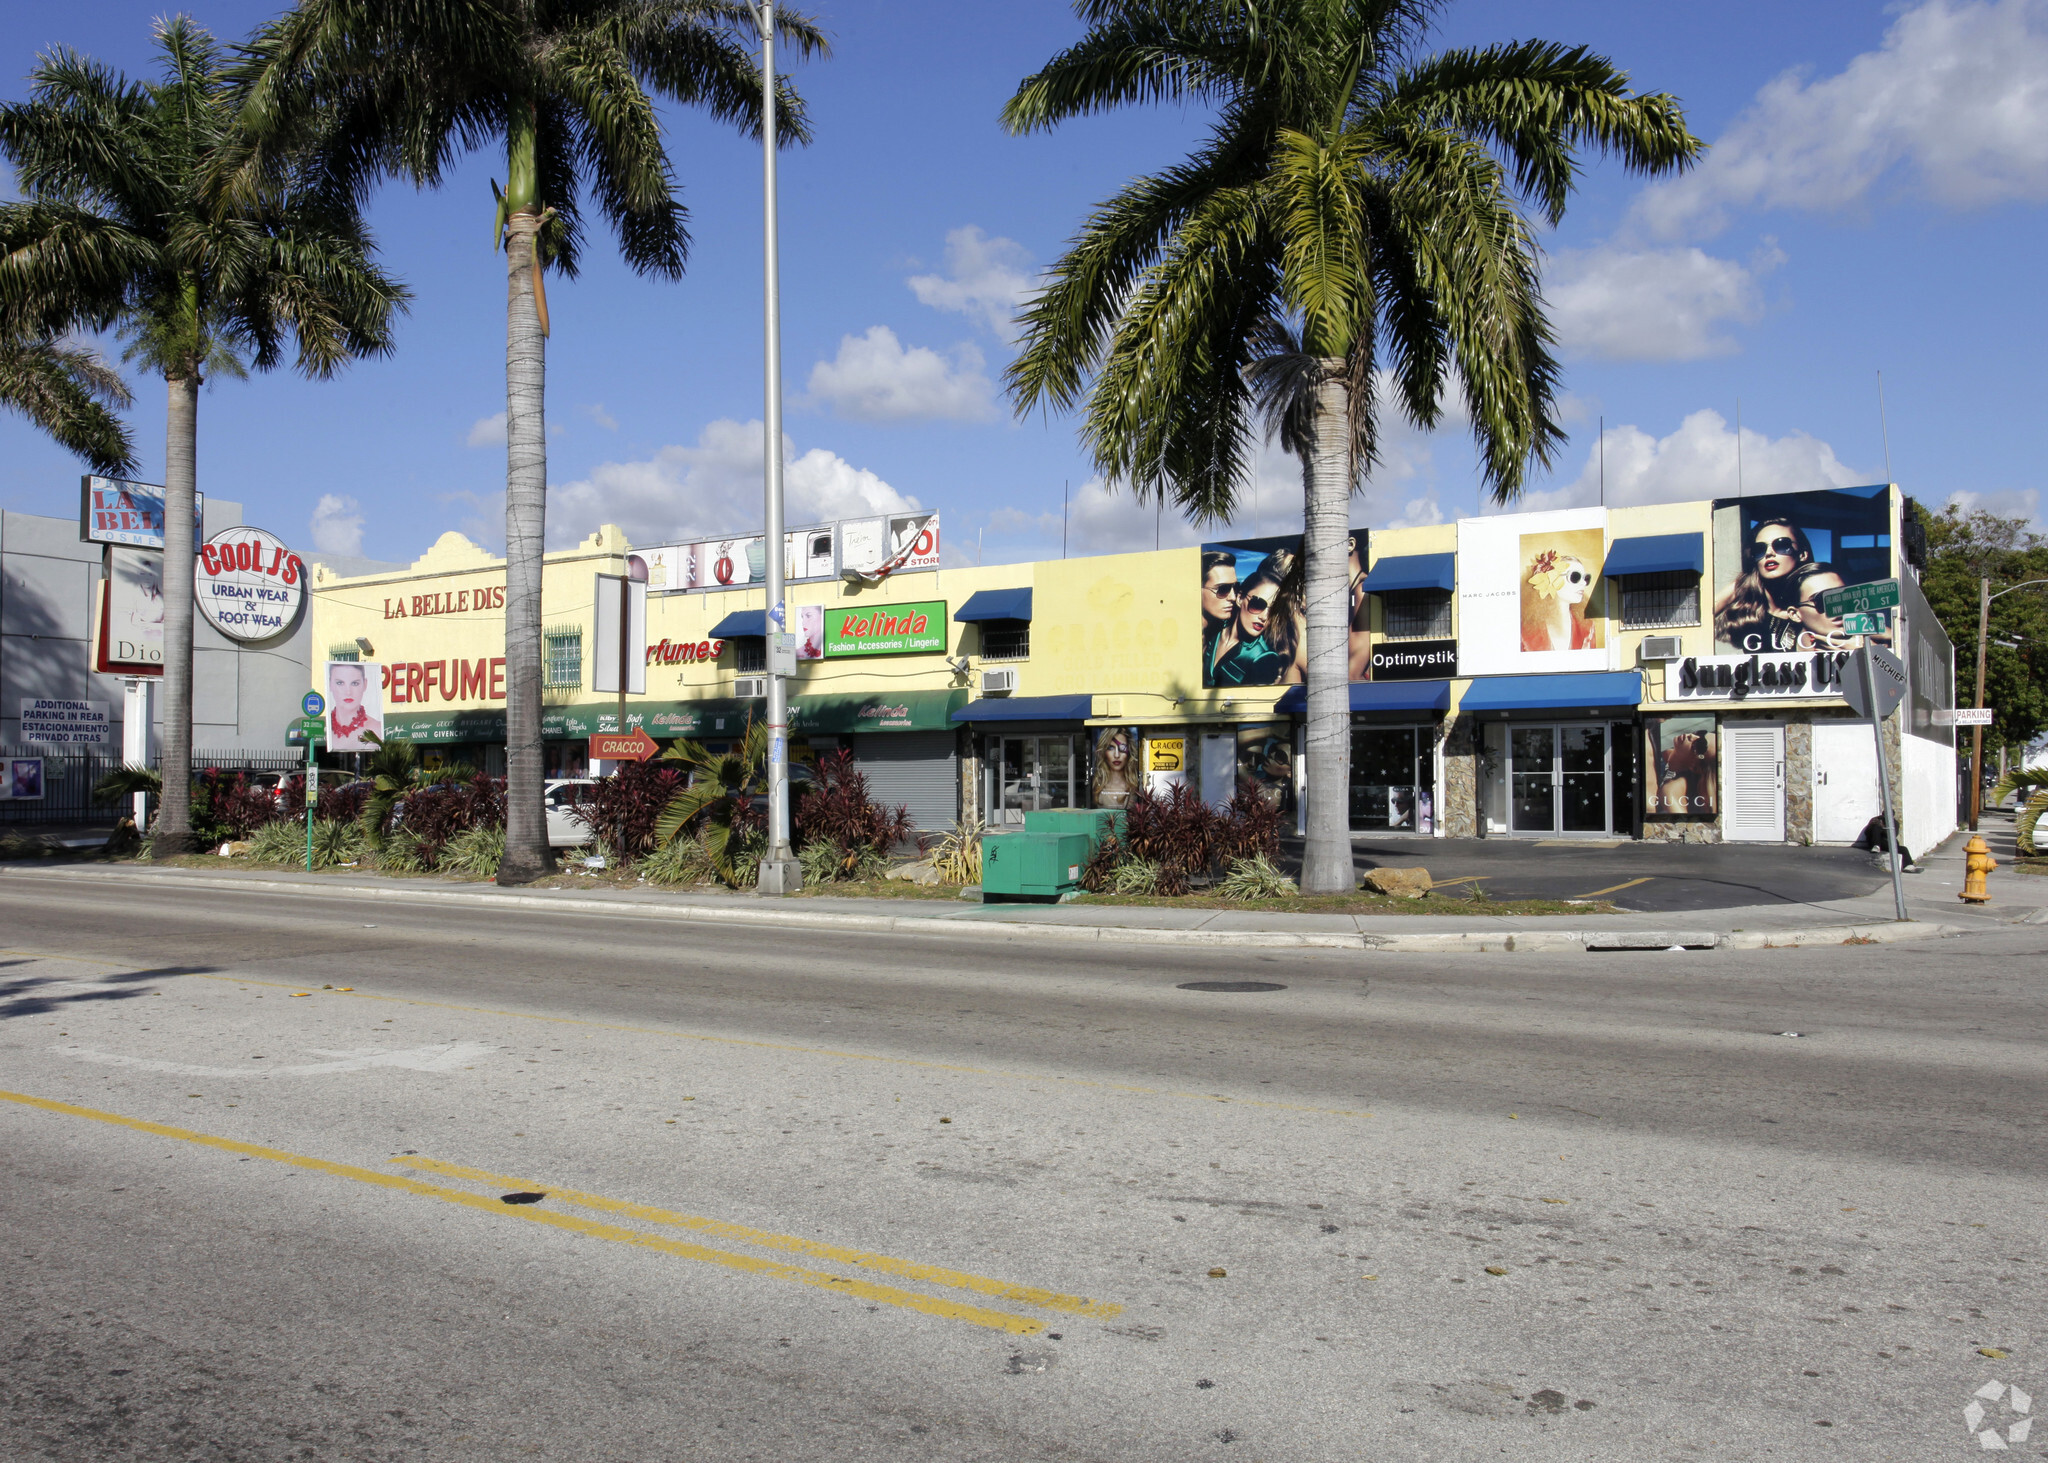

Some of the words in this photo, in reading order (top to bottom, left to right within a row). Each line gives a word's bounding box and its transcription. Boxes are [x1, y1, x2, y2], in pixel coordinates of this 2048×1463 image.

[93, 491, 136, 509] LA
[202, 540, 263, 576] COOL
[266, 547, 302, 585] J'S
[212, 584, 253, 599] URBAN
[256, 588, 289, 602] WEAR
[1486, 590, 1517, 598] JACOBS
[1868, 586, 1876, 595] THE
[1876, 583, 1896, 594] AMERICAS
[244, 601, 257, 612] &
[384, 597, 408, 619] LA
[412, 590, 469, 616] BELLE
[473, 585, 507, 610] DIS
[1832, 605, 1843, 614] NW
[1853, 597, 1870, 613] 20
[1880, 596, 1890, 606] ST
[219, 611, 249, 624] FOOT
[252, 614, 282, 627] WEAR
[840, 609, 928, 639] Kelinda
[1845, 620, 1857, 631] NW
[1861, 617, 1875, 632] 23
[828, 642, 856, 652] Fashion
[858, 640, 903, 651] Accessories
[909, 636, 940, 649] Lingerie
[1743, 630, 1861, 652] GUCCI
[118, 640, 161, 661] Dio
[646, 638, 725, 662] rfumes
[1373, 651, 1455, 669] Optimystik
[1682, 655, 1807, 696] Sunglass
[1815, 651, 1850, 685] US
[1872, 654, 1905, 682] MISCHIEF
[381, 657, 507, 703] PERFUME
[35, 700, 90, 711] ADDITIONAL
[858, 703, 909, 718] Kelinda
[23, 710, 65, 720] PARKING
[68, 712, 77, 720] IN
[80, 713, 104, 721] REAR
[626, 713, 645, 723] Body
[651, 712, 694, 725] Kelinda
[1957, 710, 1991, 719] PARKING
[22, 722, 109, 733] ESTACIONAMIENTO
[433, 729, 469, 738] GIVENCHY
[542, 726, 563, 735] CHANEL
[28, 733, 70, 742] PRIVADO
[72, 734, 102, 742] ATRAS
[1150, 738, 1183, 750] CRACCO
[602, 741, 645, 753] CRACCO
[1648, 795, 1713, 807] GUCCI
